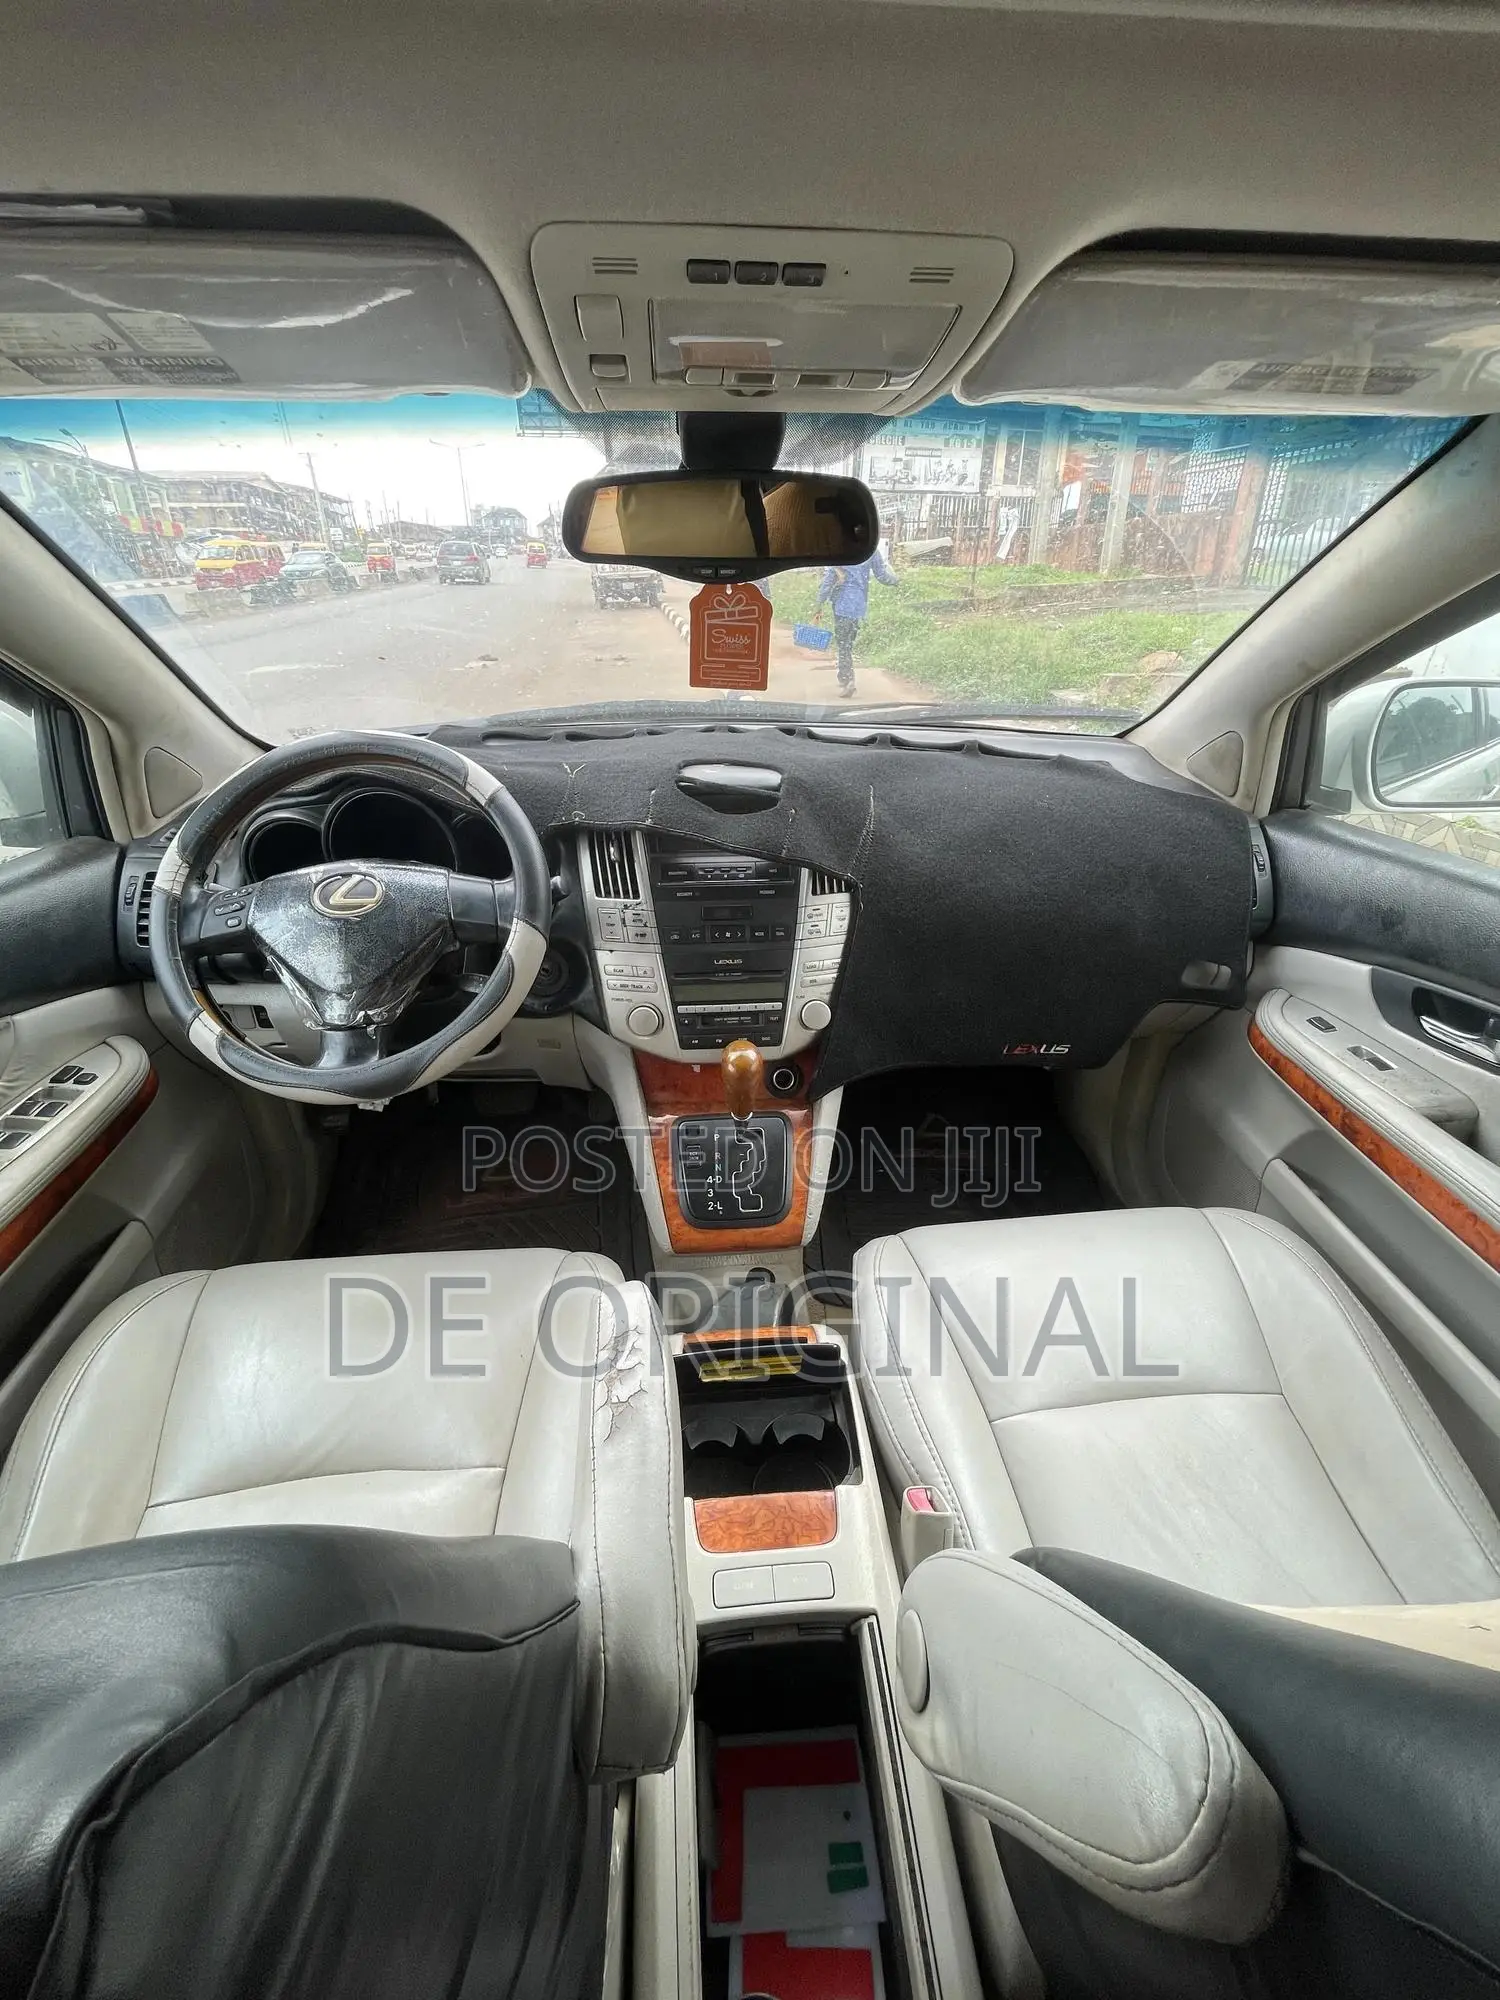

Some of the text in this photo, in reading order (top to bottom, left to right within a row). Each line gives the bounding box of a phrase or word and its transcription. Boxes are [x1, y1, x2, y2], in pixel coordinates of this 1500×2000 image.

[713, 272, 719, 281] 1
[760, 272, 768, 282] 2
[115, 356, 224, 367] WARNING
[1252, 362, 1331, 375] AIRBAG
[711, 628, 752, 644] Swiss
[1002, 1044, 1071, 1054] LEXUS
[707, 1188, 714, 1197] 3
